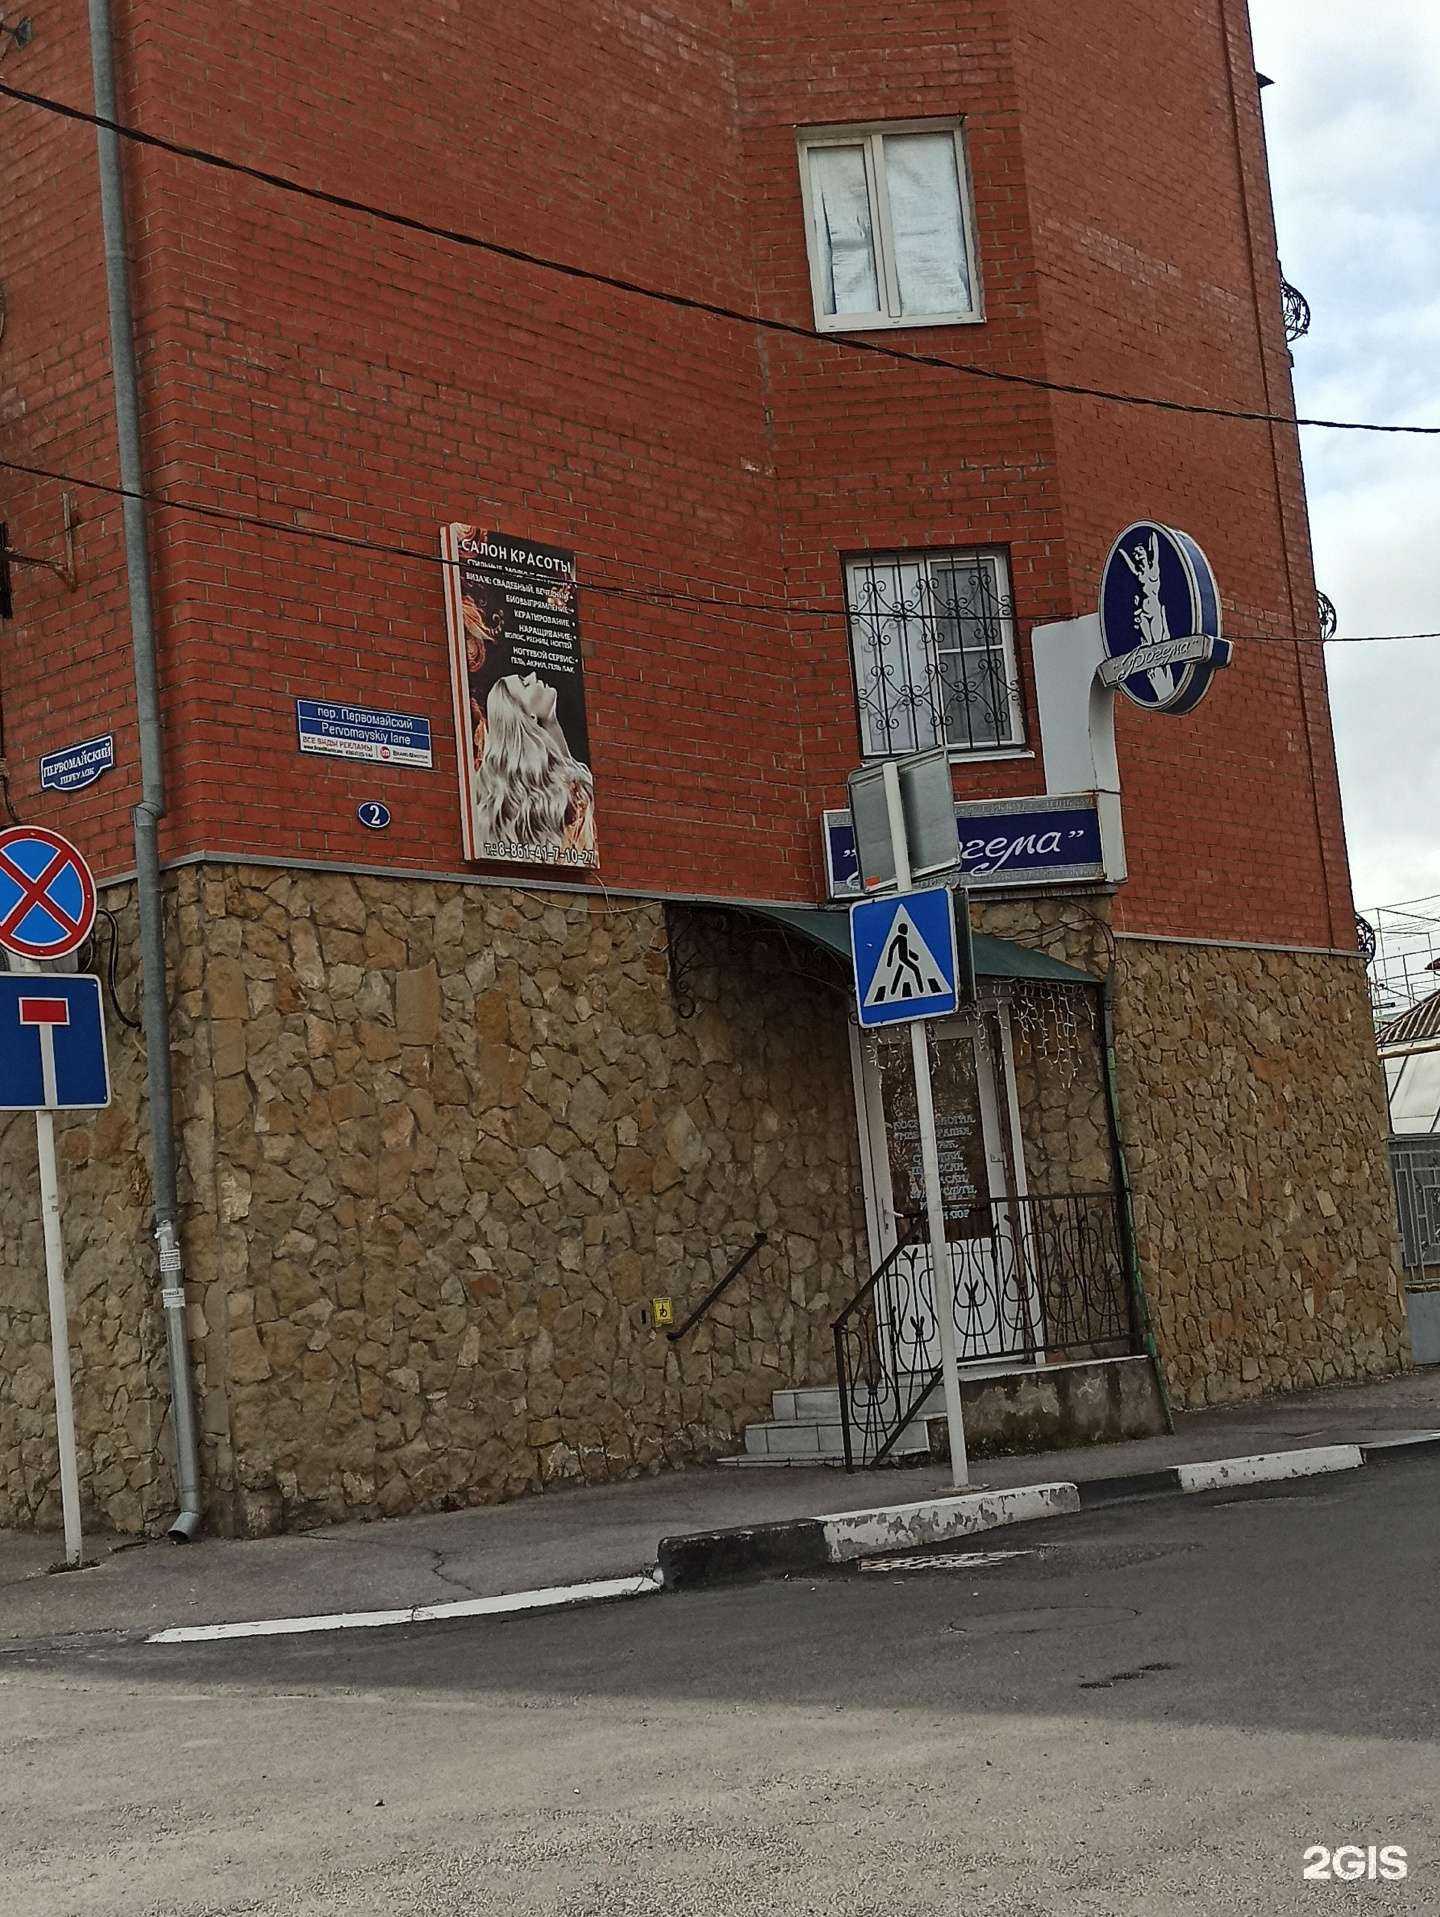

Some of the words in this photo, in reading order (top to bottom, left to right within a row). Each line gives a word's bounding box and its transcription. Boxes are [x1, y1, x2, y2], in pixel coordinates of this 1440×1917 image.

[461, 539, 507, 560] САЛОН
[510, 548, 571, 573] КРАСОТЫ
[317, 706, 339, 719] пер.
[341, 708, 414, 731] Первомайский
[321, 721, 389, 743] Pervomayskiy
[390, 732, 412, 745] lane
[43, 742, 111, 778] ПЕРВОМАЙСКИЙ
[369, 804, 381, 825] 2
